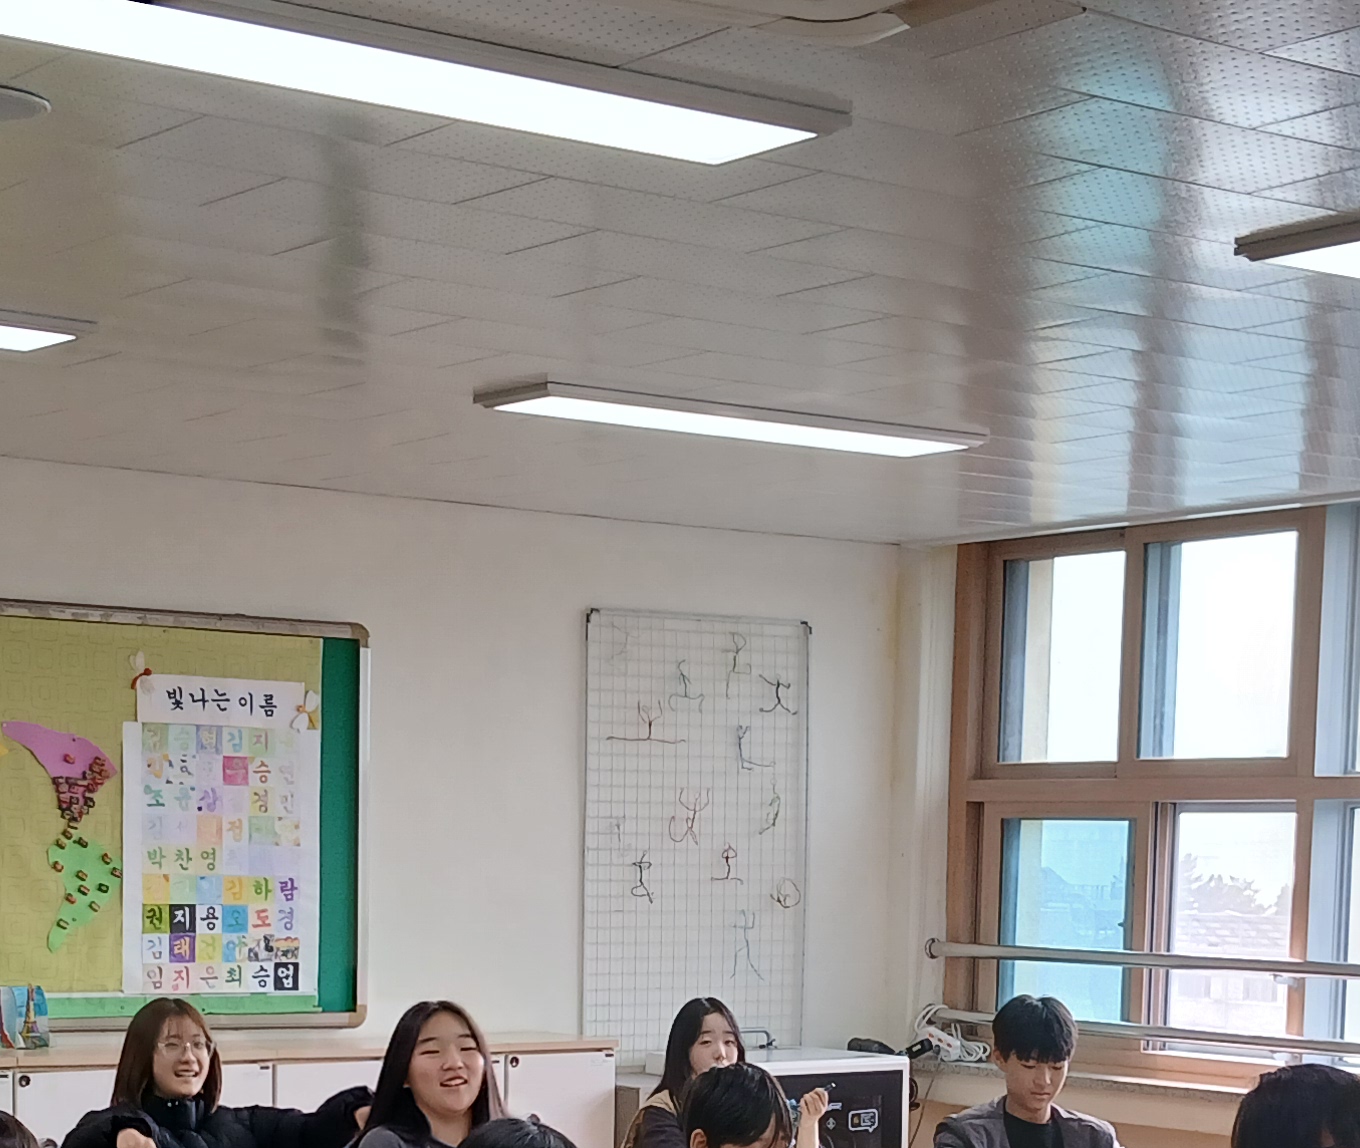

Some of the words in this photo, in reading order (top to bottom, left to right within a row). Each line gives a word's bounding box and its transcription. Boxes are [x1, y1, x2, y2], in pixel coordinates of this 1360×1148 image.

[166, 686, 230, 712] 빛나는
[238, 692, 278, 718] 이름
[147, 846, 216, 871] 박찬영
[225, 877, 298, 902] 김하람
[145, 905, 219, 931] 권지용
